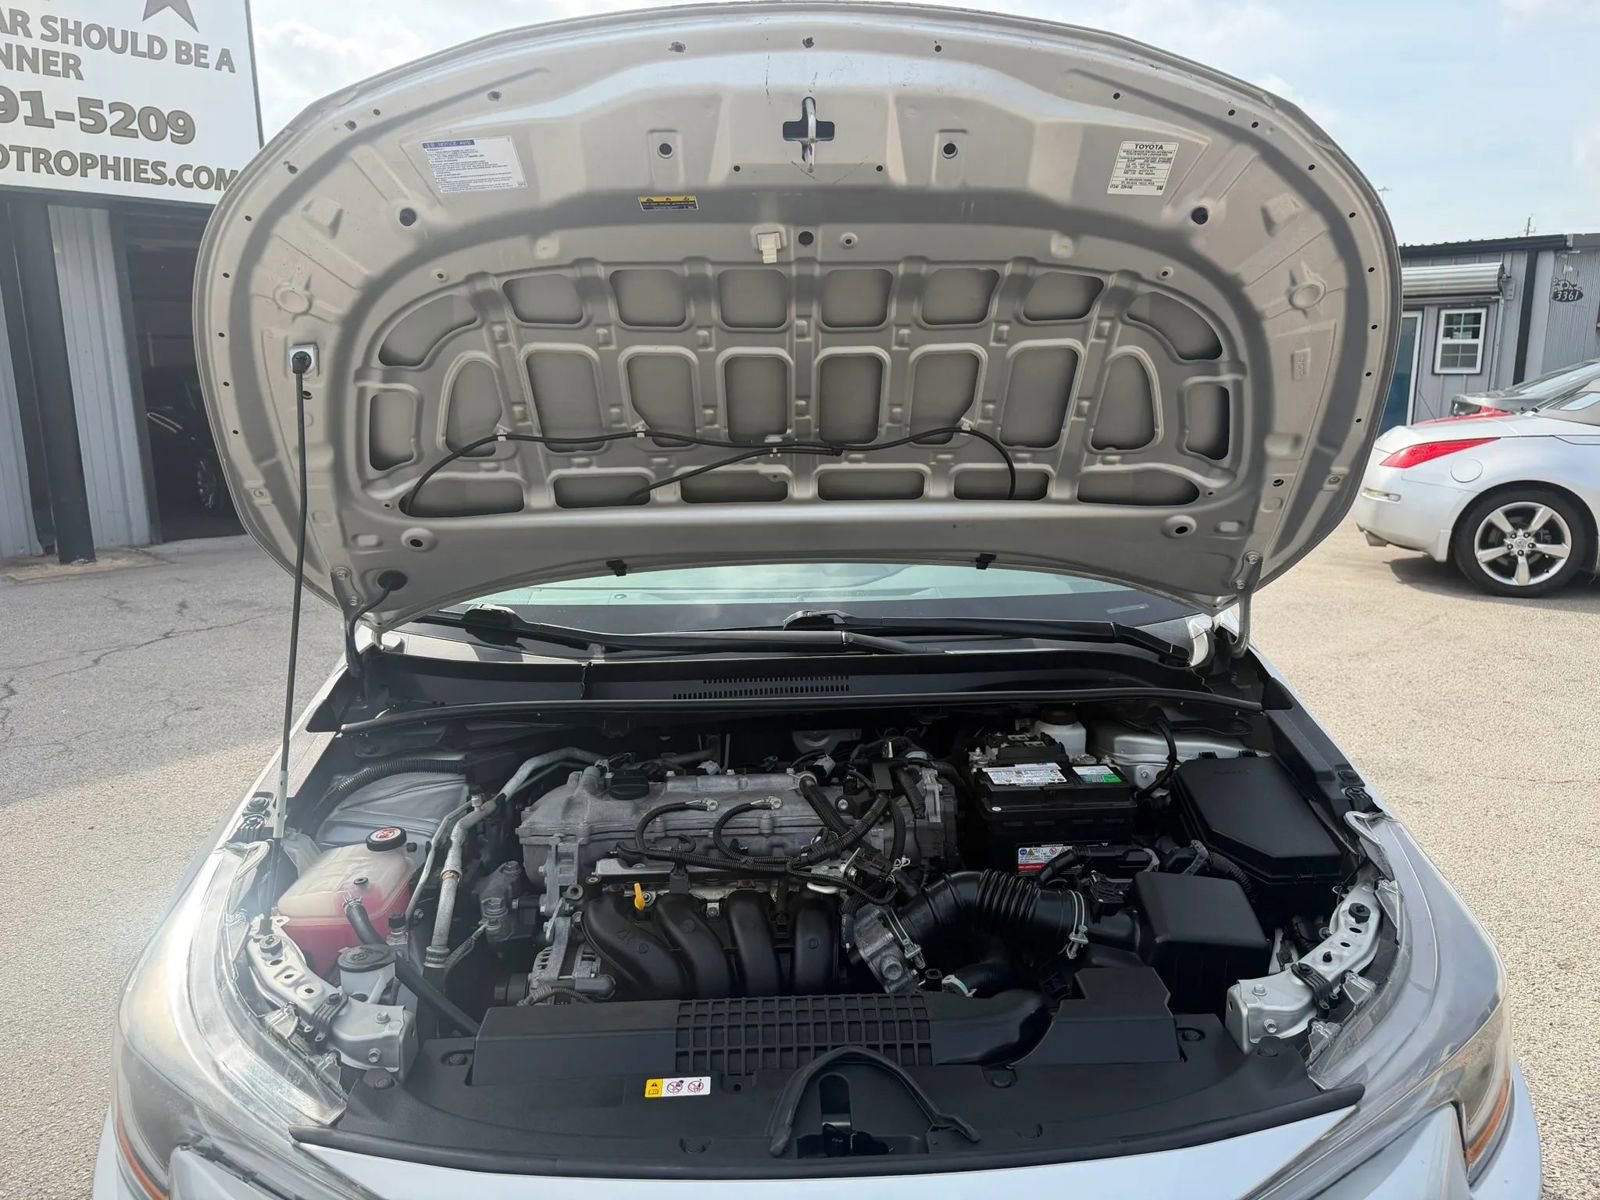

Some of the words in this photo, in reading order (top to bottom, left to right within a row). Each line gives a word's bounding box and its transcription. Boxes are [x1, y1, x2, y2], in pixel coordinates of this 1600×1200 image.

[40, 15, 168, 61] SHOULD
[174, 39, 210, 69] BE
[214, 48, 236, 74] A
[0, 85, 196, 145] 91-5209
[1555, 290, 1580, 301] 3361
